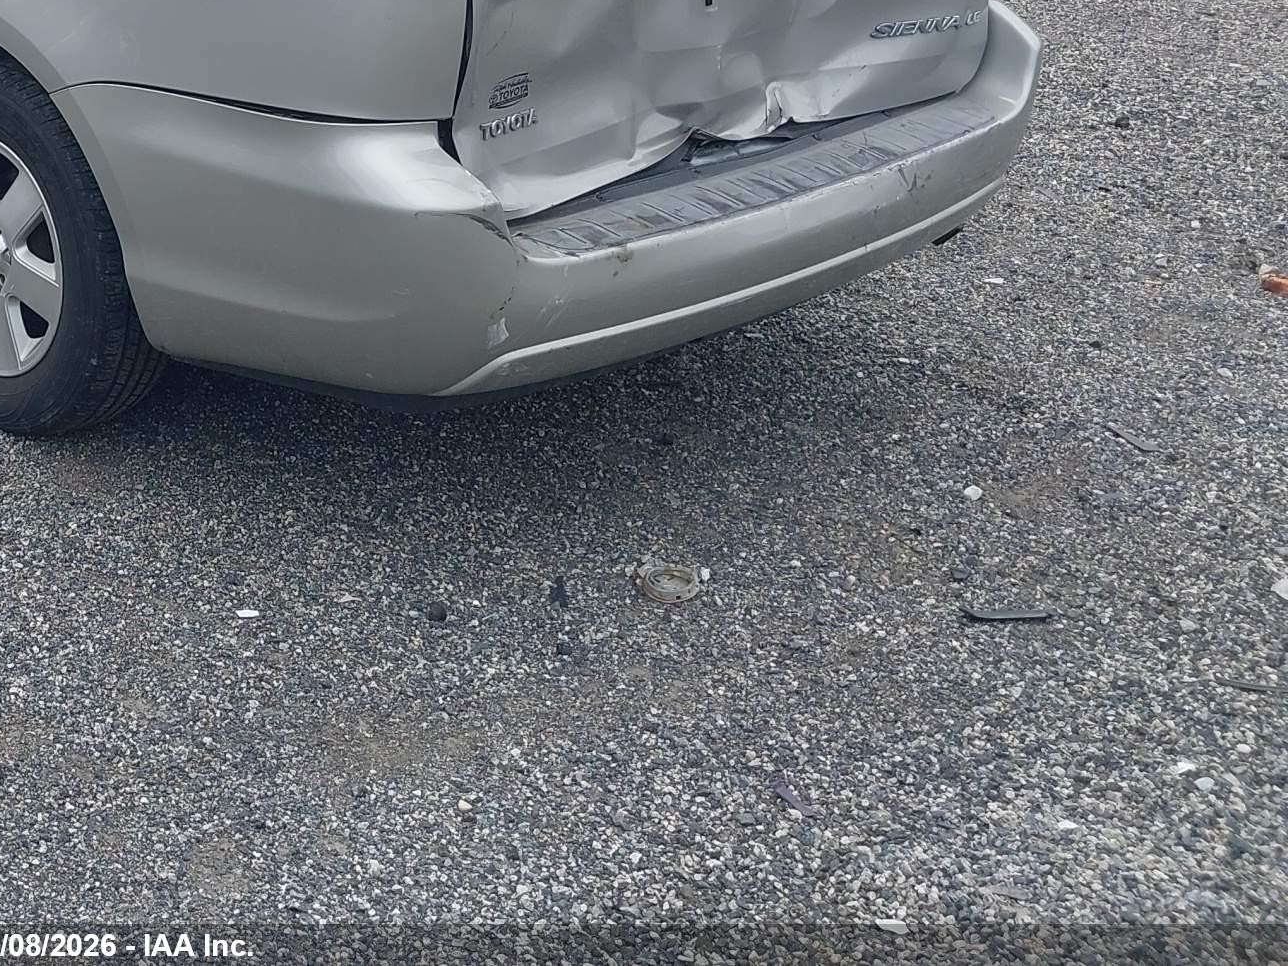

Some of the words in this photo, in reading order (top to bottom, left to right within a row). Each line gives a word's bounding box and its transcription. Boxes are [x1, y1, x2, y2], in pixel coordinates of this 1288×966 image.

[870, 15, 962, 39] SIENNA
[964, 10, 982, 26] LE
[499, 84, 529, 101] TOYOTA
[479, 107, 537, 141] TOYOTA
